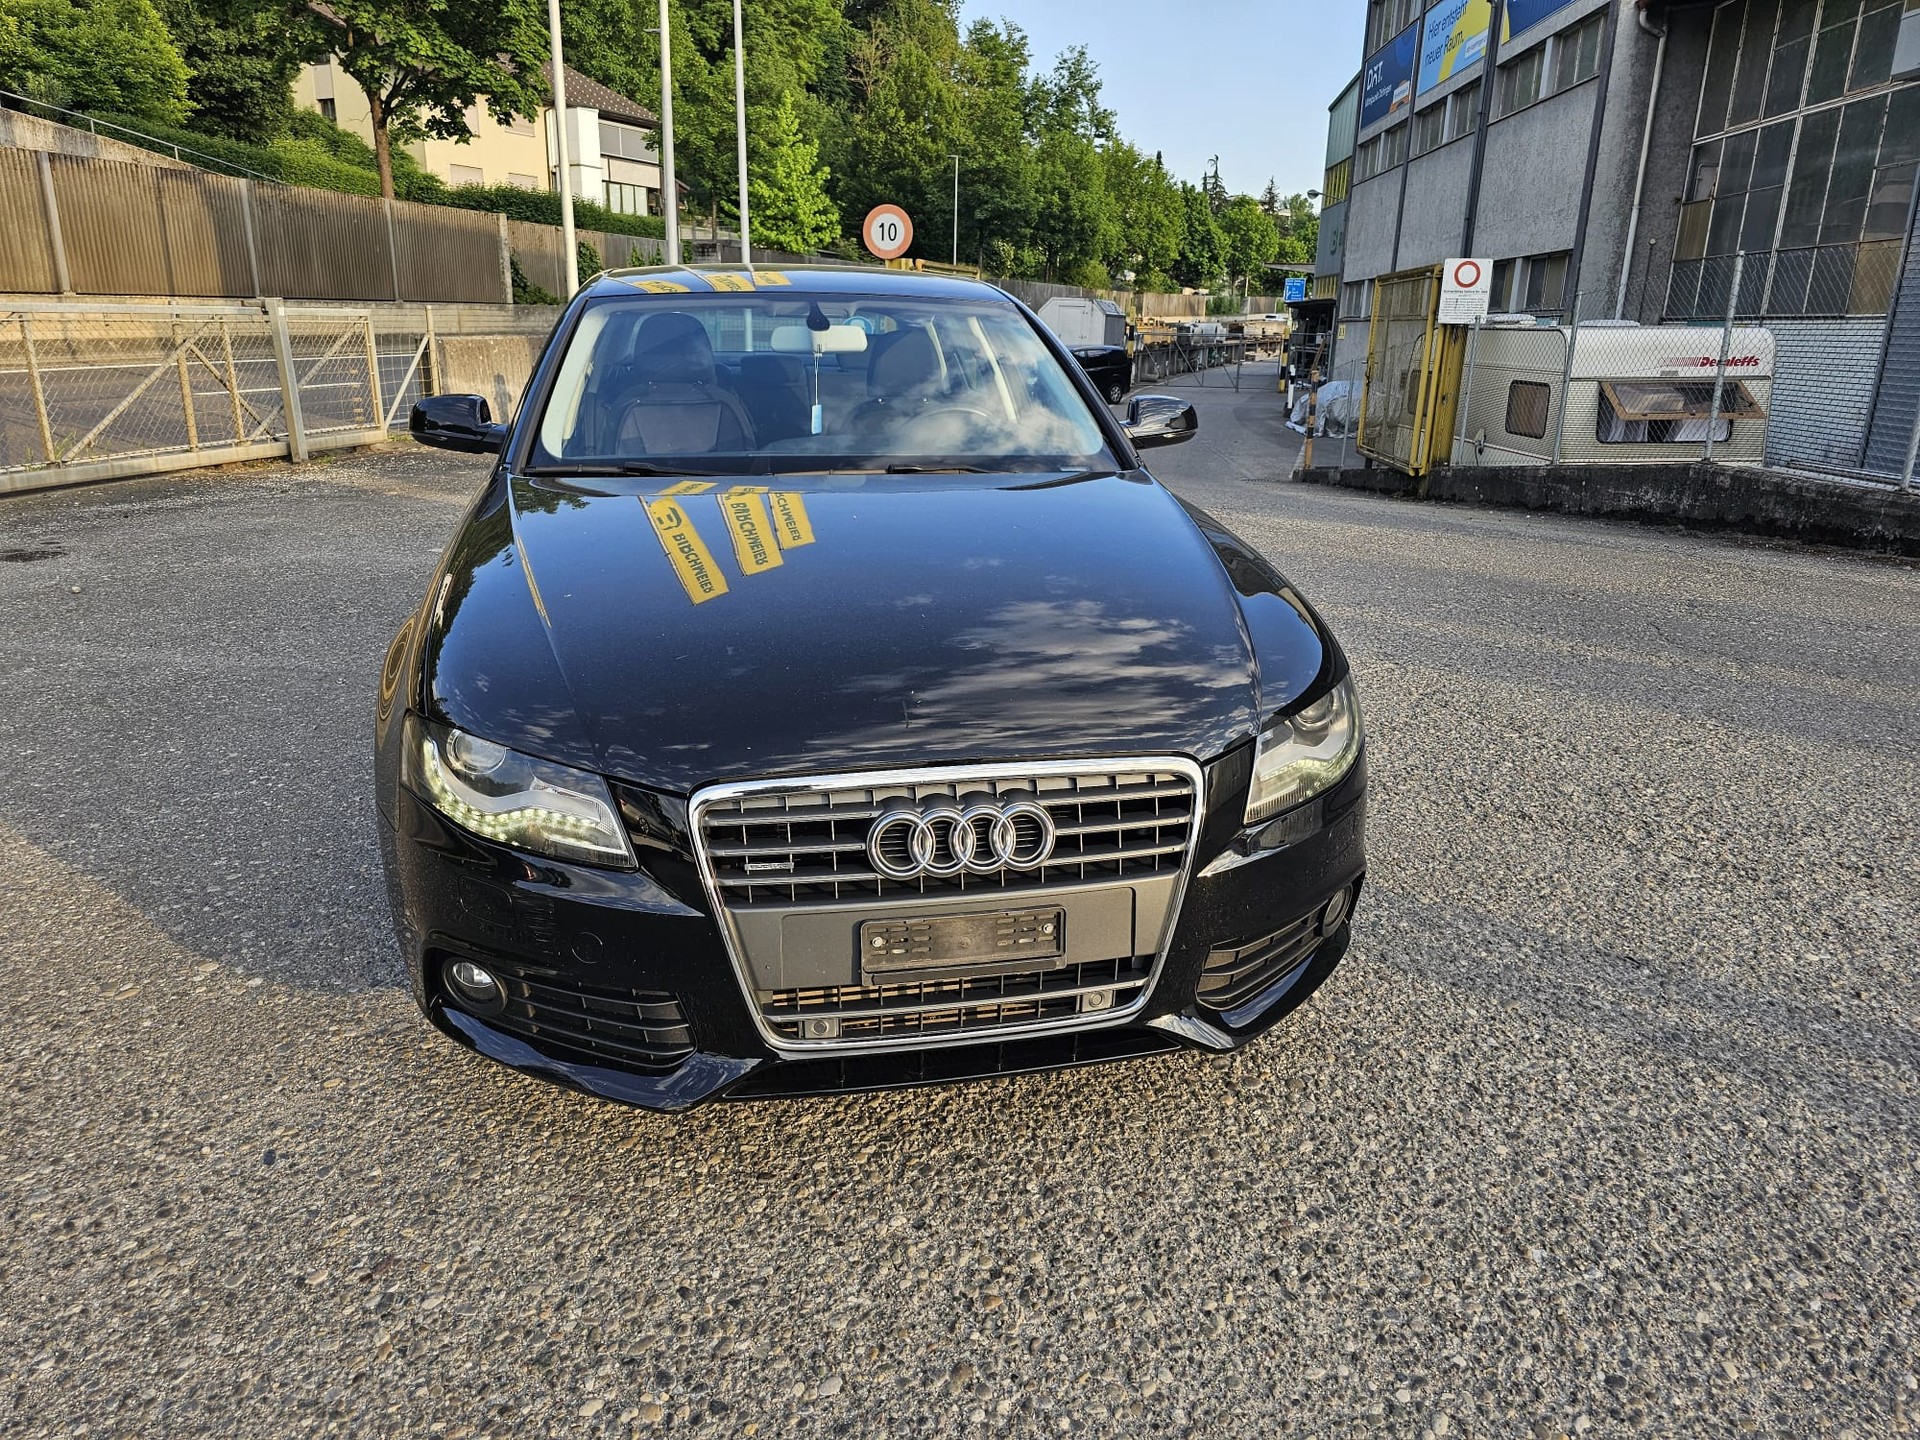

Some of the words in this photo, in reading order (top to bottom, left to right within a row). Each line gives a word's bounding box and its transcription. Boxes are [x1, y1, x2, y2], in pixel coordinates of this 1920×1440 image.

[1424, 44, 1444, 67] neuer
[878, 222, 898, 242] 10
[1700, 355, 1760, 368] Deleffs
